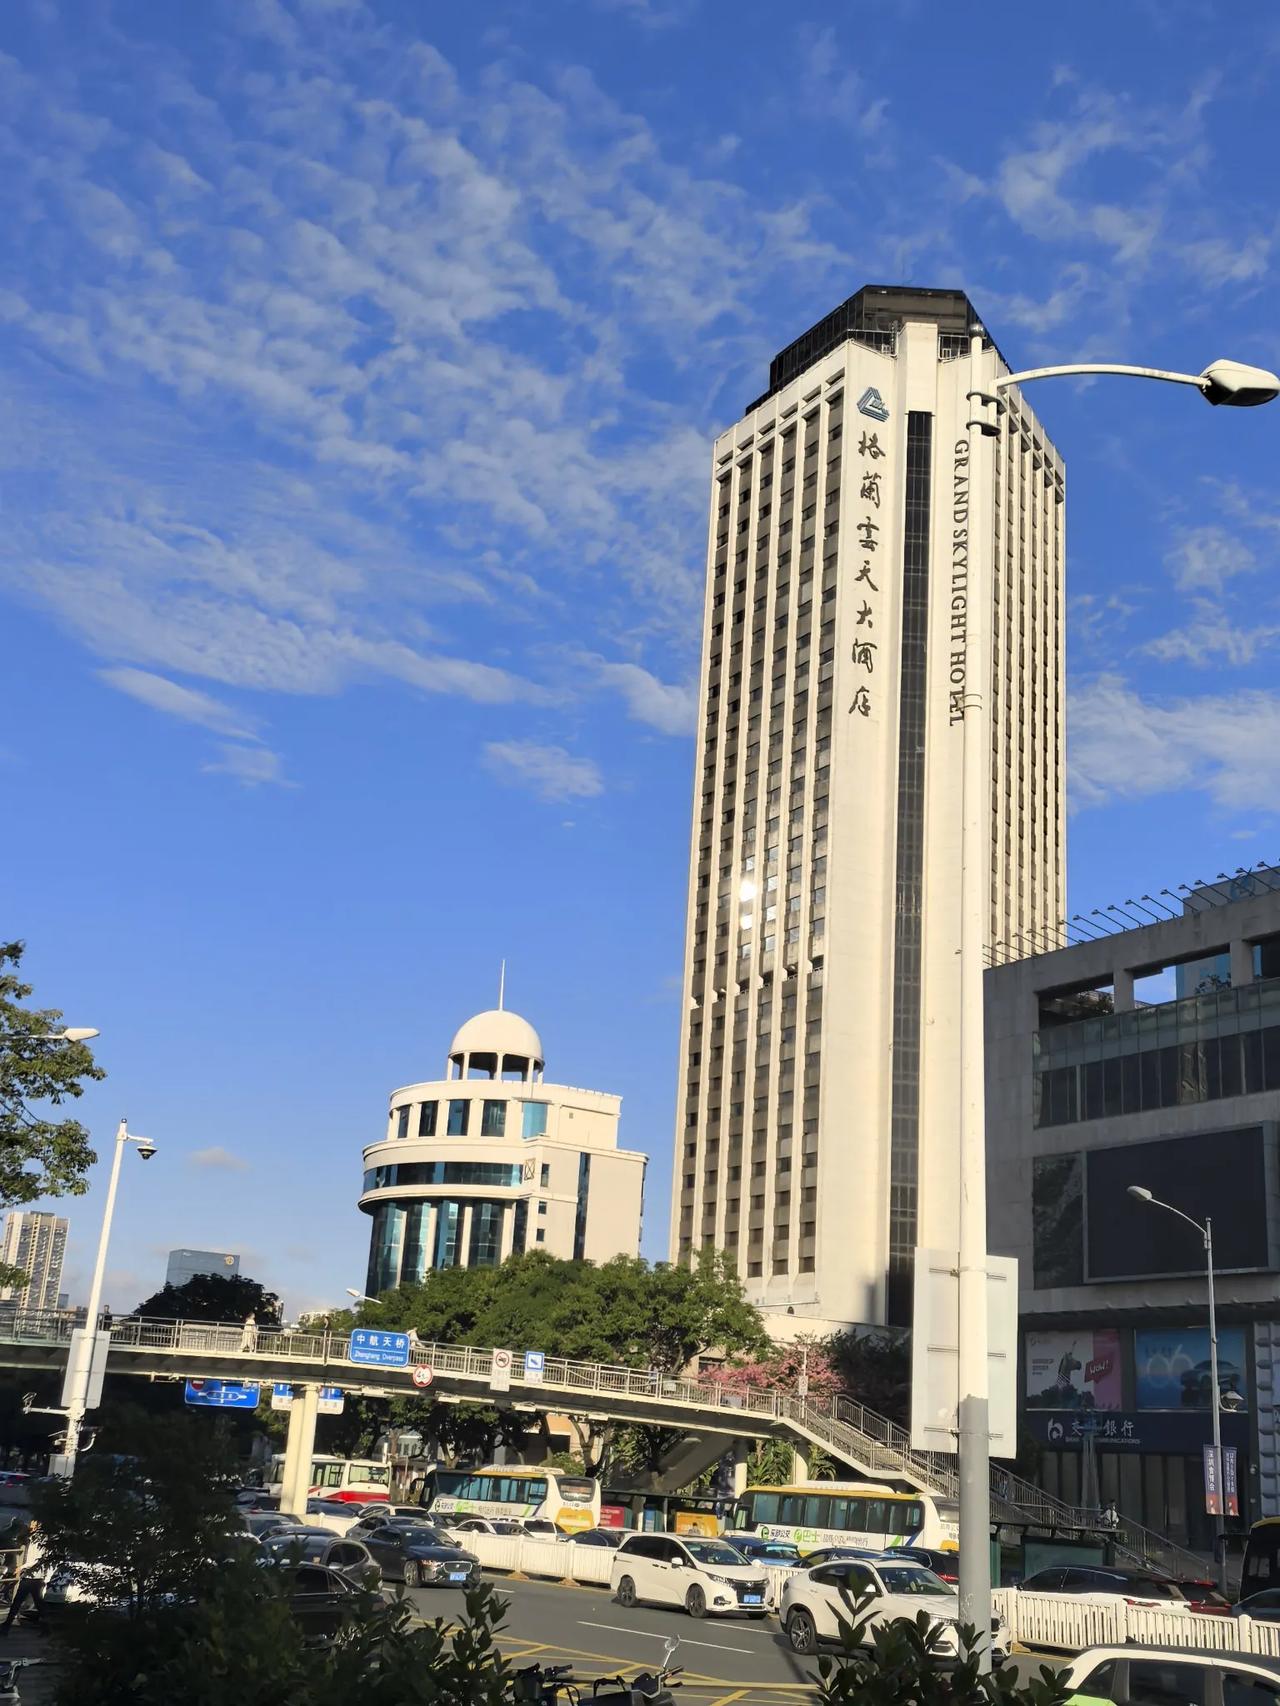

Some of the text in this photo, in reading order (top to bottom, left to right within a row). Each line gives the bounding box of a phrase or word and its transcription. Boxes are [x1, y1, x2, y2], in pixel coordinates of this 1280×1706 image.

[953, 439, 969, 524] GRAND
[951, 528, 968, 643] SKYLIGHT
[356, 1334, 405, 1349] 中航天桥
[1071, 1417, 1134, 1438] 交銀行
